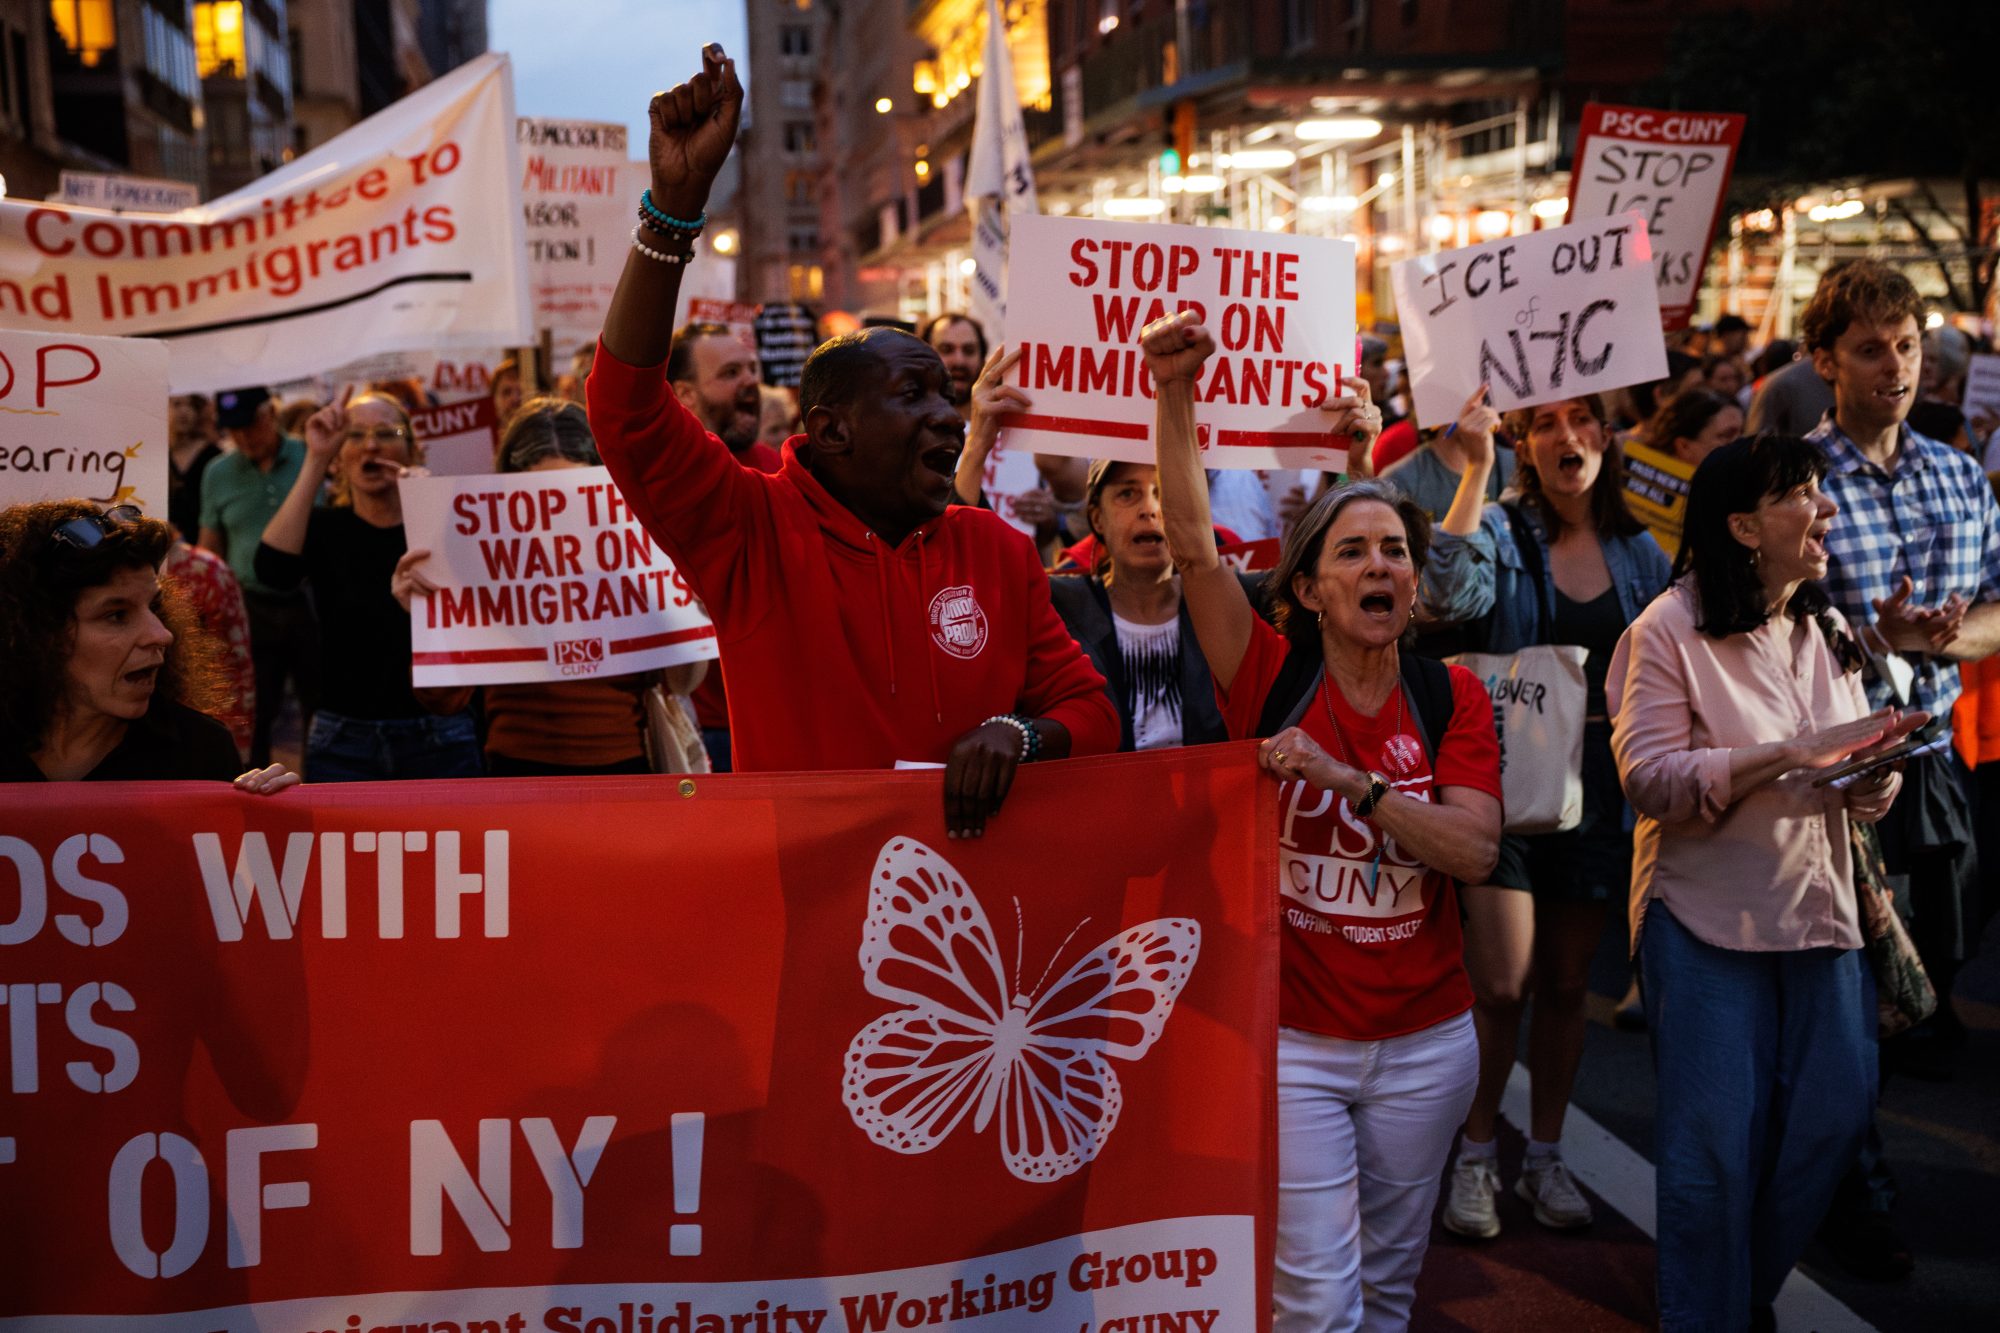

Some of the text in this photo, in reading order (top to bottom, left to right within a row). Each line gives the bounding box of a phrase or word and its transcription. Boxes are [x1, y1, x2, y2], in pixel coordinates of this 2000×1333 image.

[1601, 110, 1729, 142] PSC-CUNY
[407, 142, 461, 186] to
[522, 155, 616, 196] MILITANT
[1596, 146, 1715, 187] STOP
[97, 206, 456, 320] Immigrants
[1068, 238, 1300, 301] STOP THE
[1422, 225, 1632, 316] ICE OUT
[1220, 302, 1286, 354] ON
[1514, 296, 1540, 328] of
[1018, 341, 1342, 409] IMMIANTS!
[1478, 299, 1617, 408] NYC
[453, 483, 635, 537] STOP TH
[479, 527, 652, 581] WAR ON
[425, 568, 693, 629] IMMIGRANTS
[556, 640, 602, 664] PSC
[561, 662, 599, 676] CUNY
[192, 830, 510, 942] WITH
[1288, 860, 1416, 908] CUNY
[1287, 908, 1333, 934] STAFFING
[1342, 925, 1385, 944] STUDENT
[108, 1123, 318, 1280] OF
[410, 1115, 618, 1257] NY
[840, 1271, 1057, 1333] Working
[1068, 1247, 1218, 1293] Group
